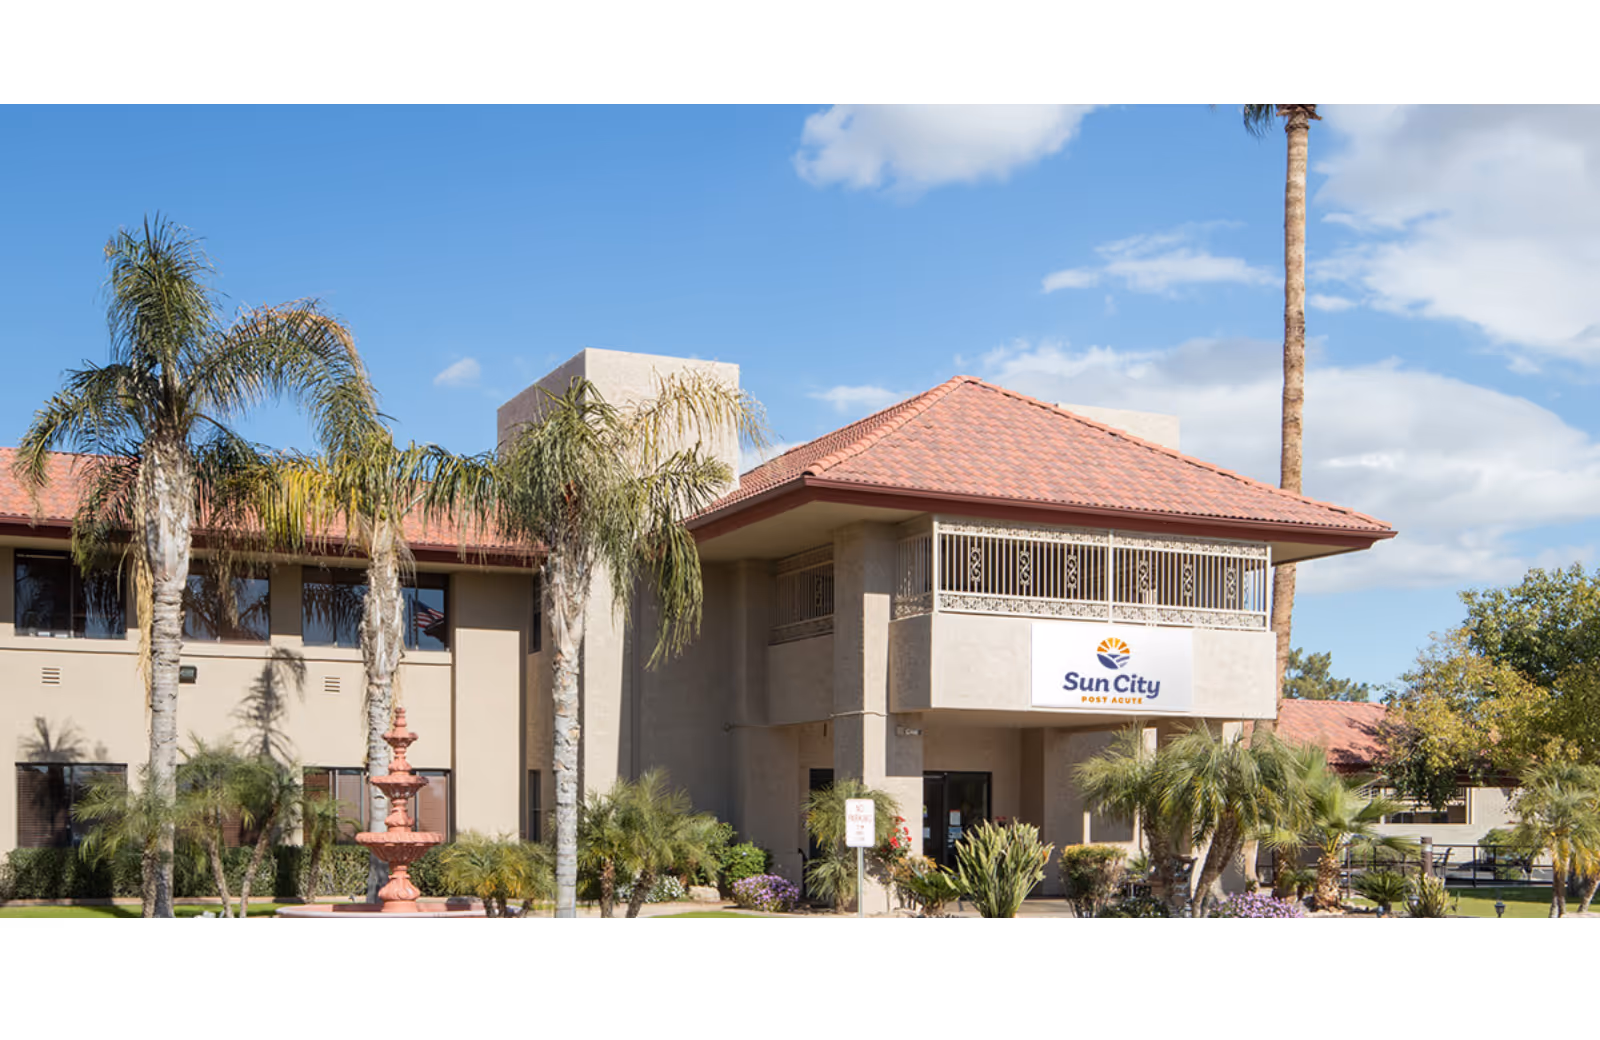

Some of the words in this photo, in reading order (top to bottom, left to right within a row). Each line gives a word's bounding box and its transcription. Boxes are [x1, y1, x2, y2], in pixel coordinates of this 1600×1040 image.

[1062, 672, 1109, 691] Sun
[1114, 674, 1161, 699] City
[1081, 696, 1108, 704] POST
